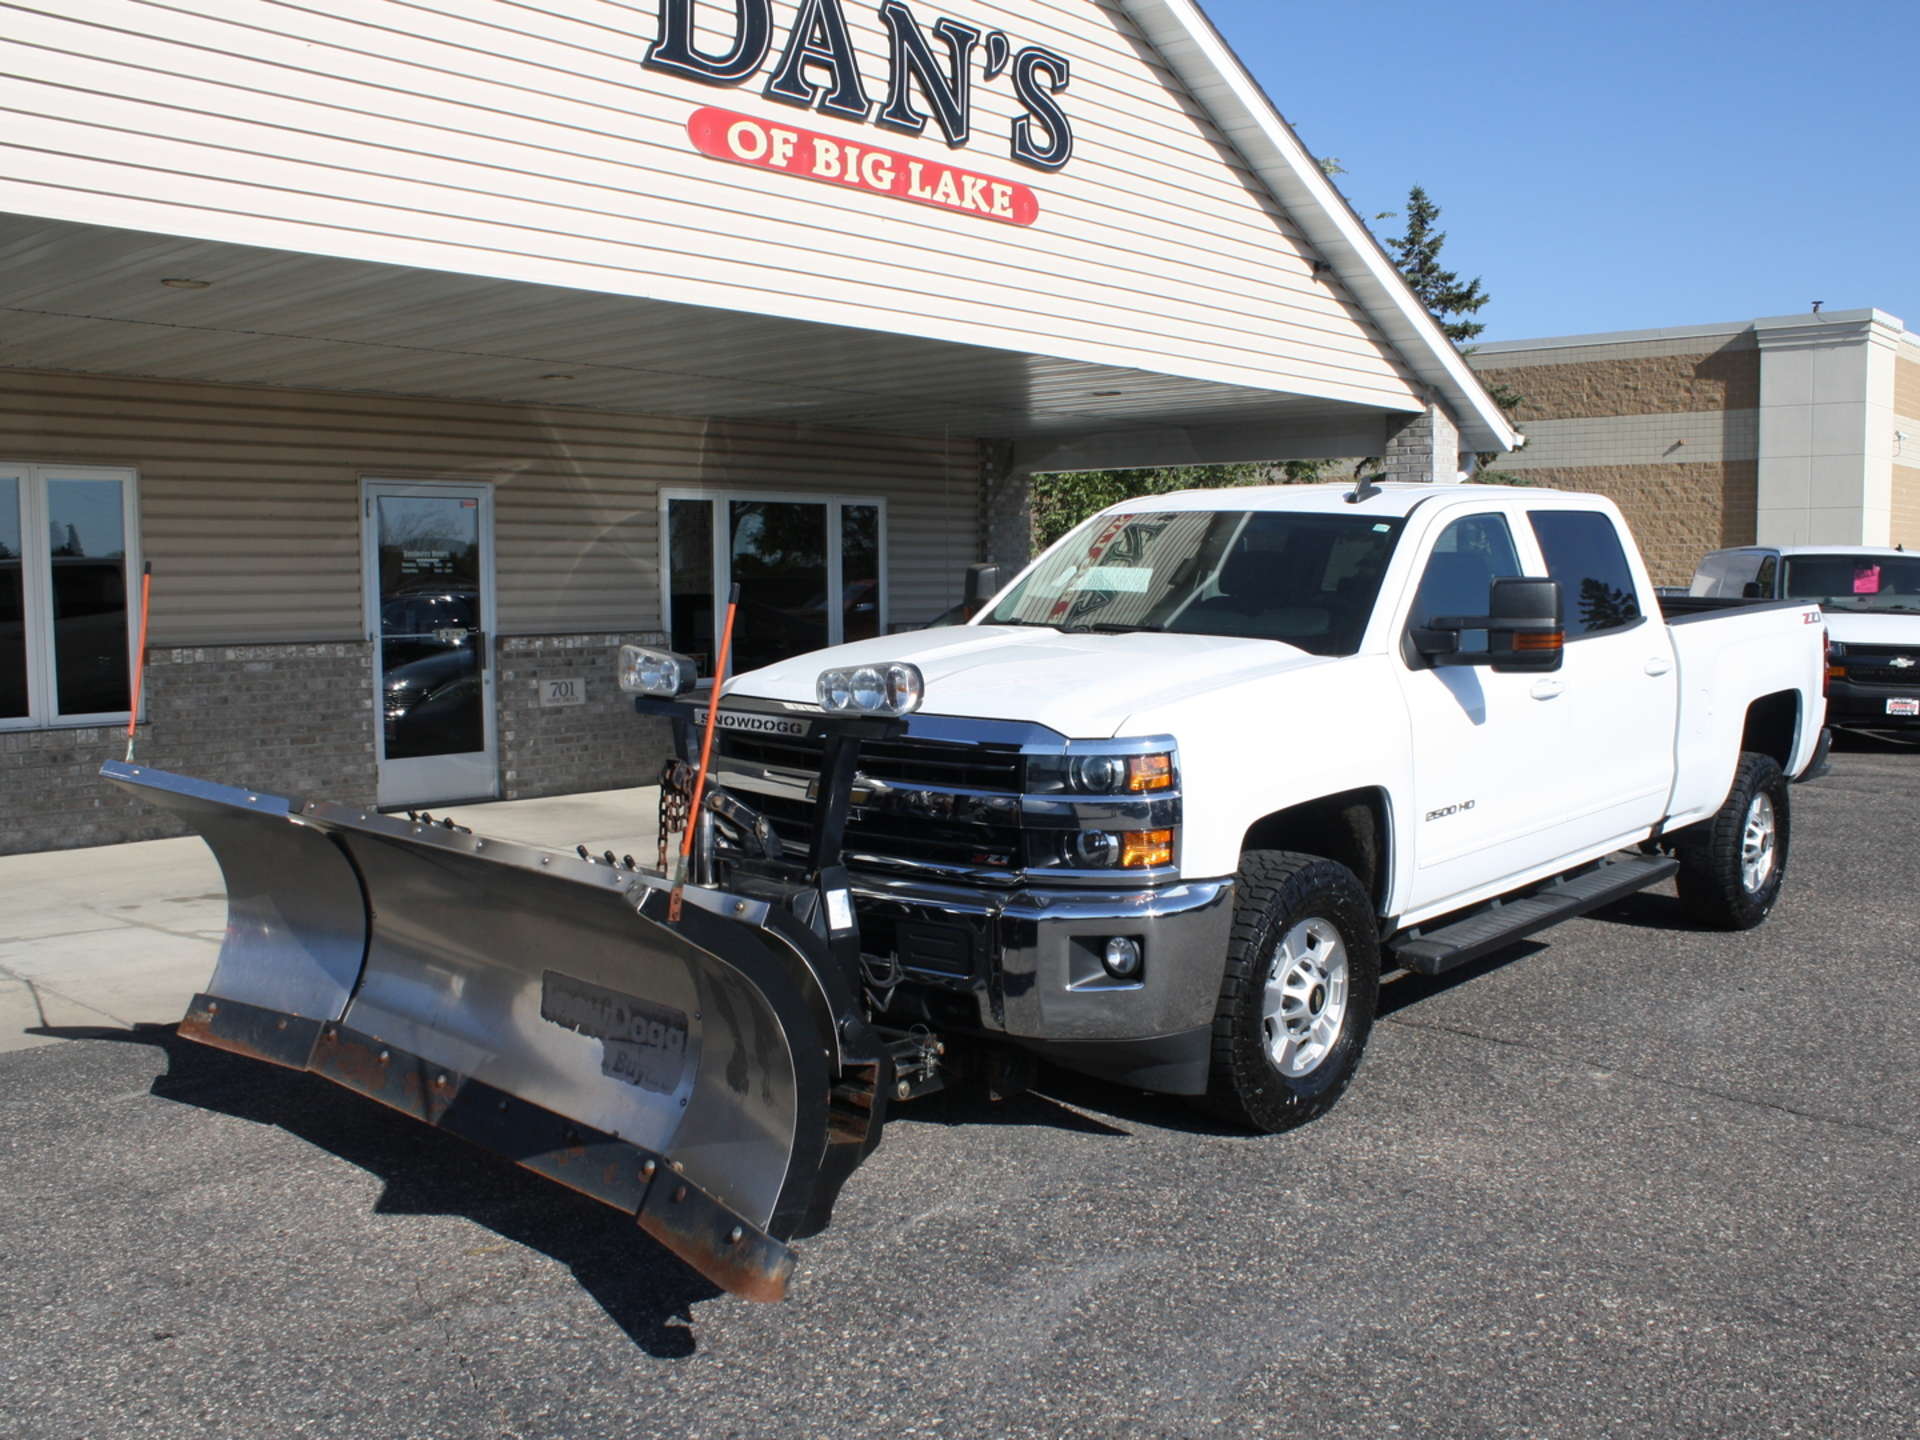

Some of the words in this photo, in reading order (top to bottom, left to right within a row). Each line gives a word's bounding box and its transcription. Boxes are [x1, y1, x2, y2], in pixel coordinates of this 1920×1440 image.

[641, 0, 1072, 172] DAN'S
[727, 120, 797, 167] OF
[812, 138, 895, 189] BIG
[908, 162, 1013, 219] LAKE
[550, 681, 575, 698] 701
[1425, 804, 1456, 822] 2500
[1458, 799, 1475, 812] HD
